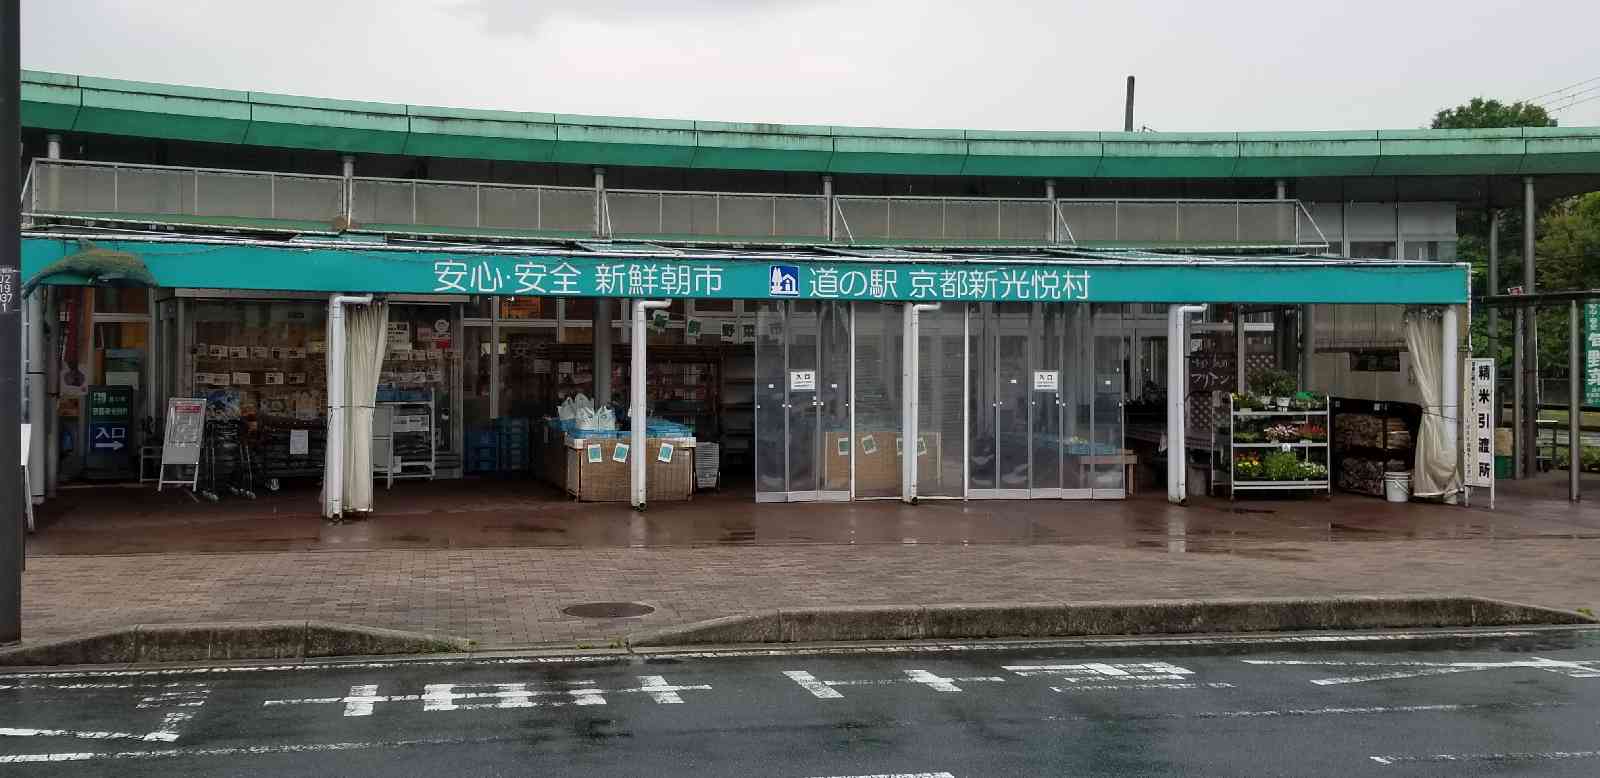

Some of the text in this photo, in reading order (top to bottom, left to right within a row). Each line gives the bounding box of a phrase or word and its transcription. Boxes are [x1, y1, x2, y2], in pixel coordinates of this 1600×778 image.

[594, 263, 724, 296] 新鮮朝市
[809, 267, 898, 299] 道の駅
[909, 268, 1092, 301] 京都新光悦村
[94, 426, 127, 440] 入口
